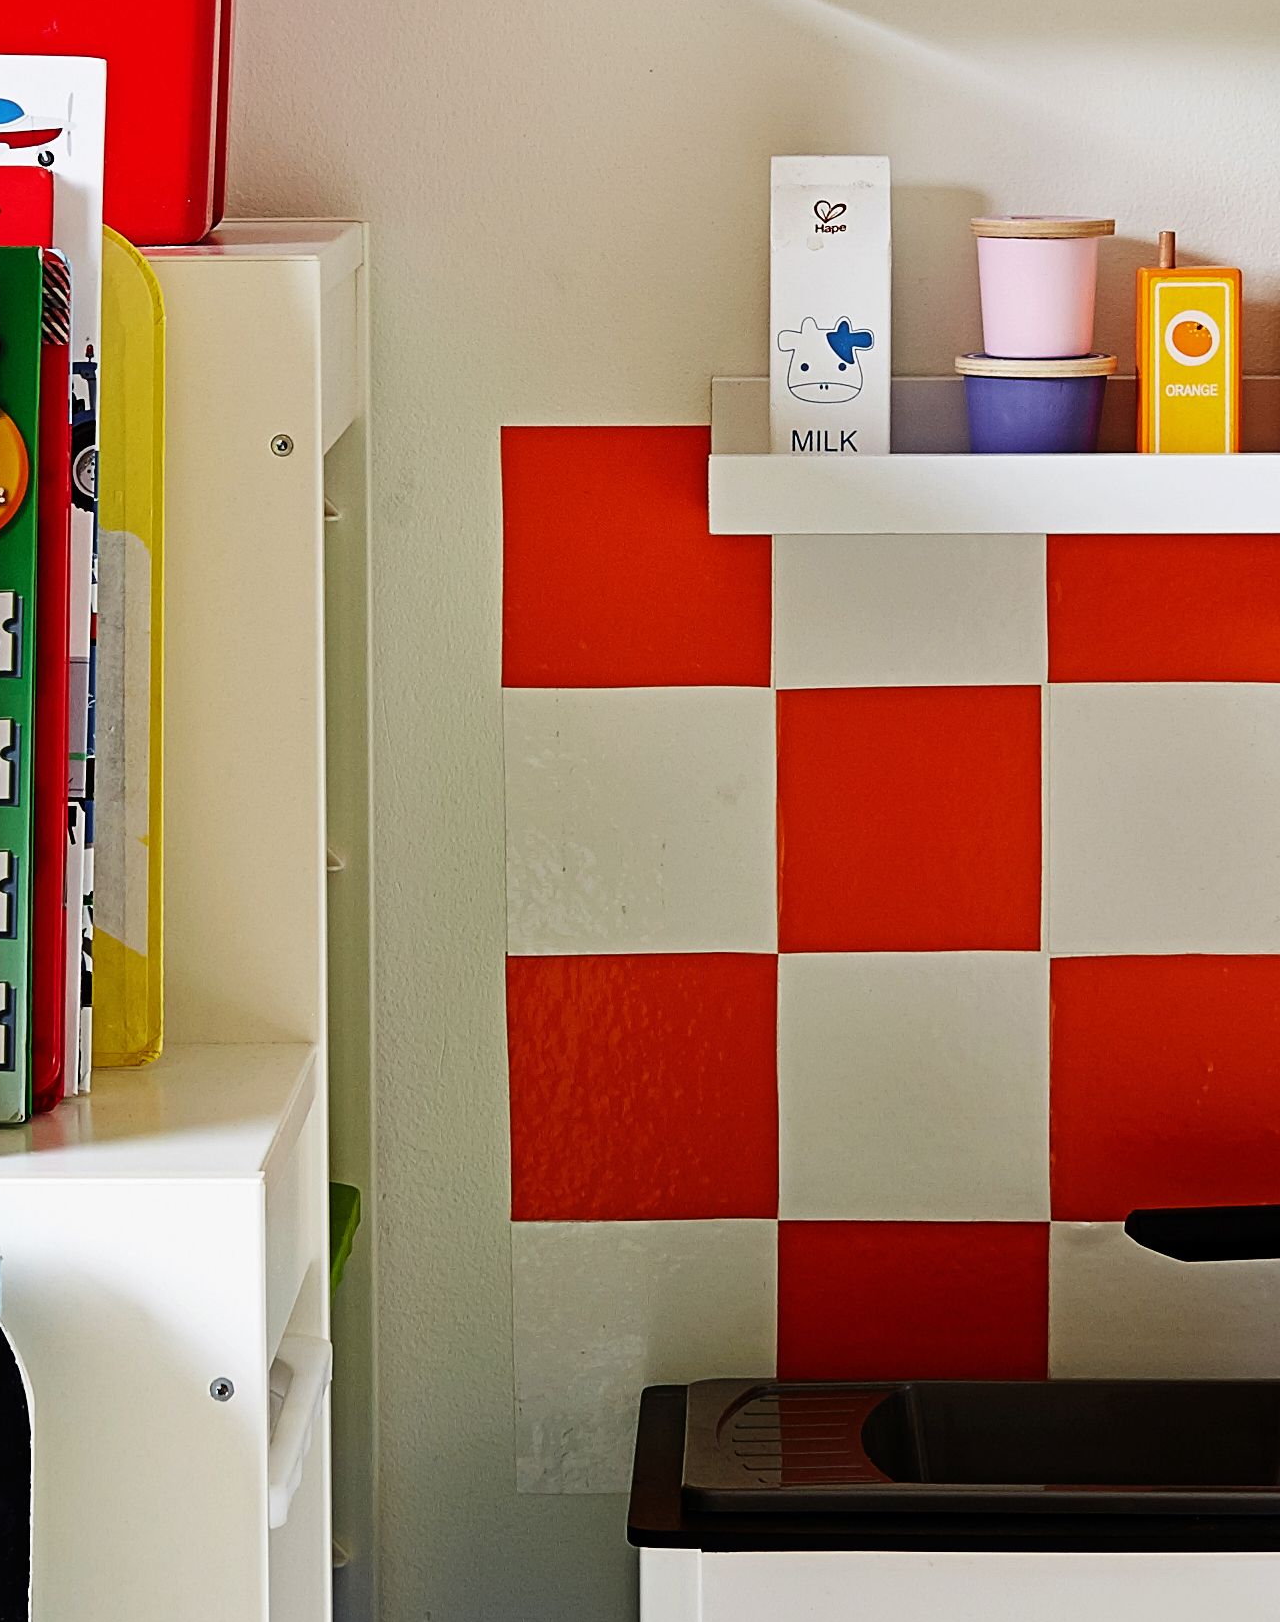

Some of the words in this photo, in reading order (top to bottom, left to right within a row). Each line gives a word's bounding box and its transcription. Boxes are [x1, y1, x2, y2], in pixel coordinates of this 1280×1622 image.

[814, 223, 848, 235] Hape
[1165, 383, 1219, 397] ORANGE
[791, 429, 858, 452] MILK
